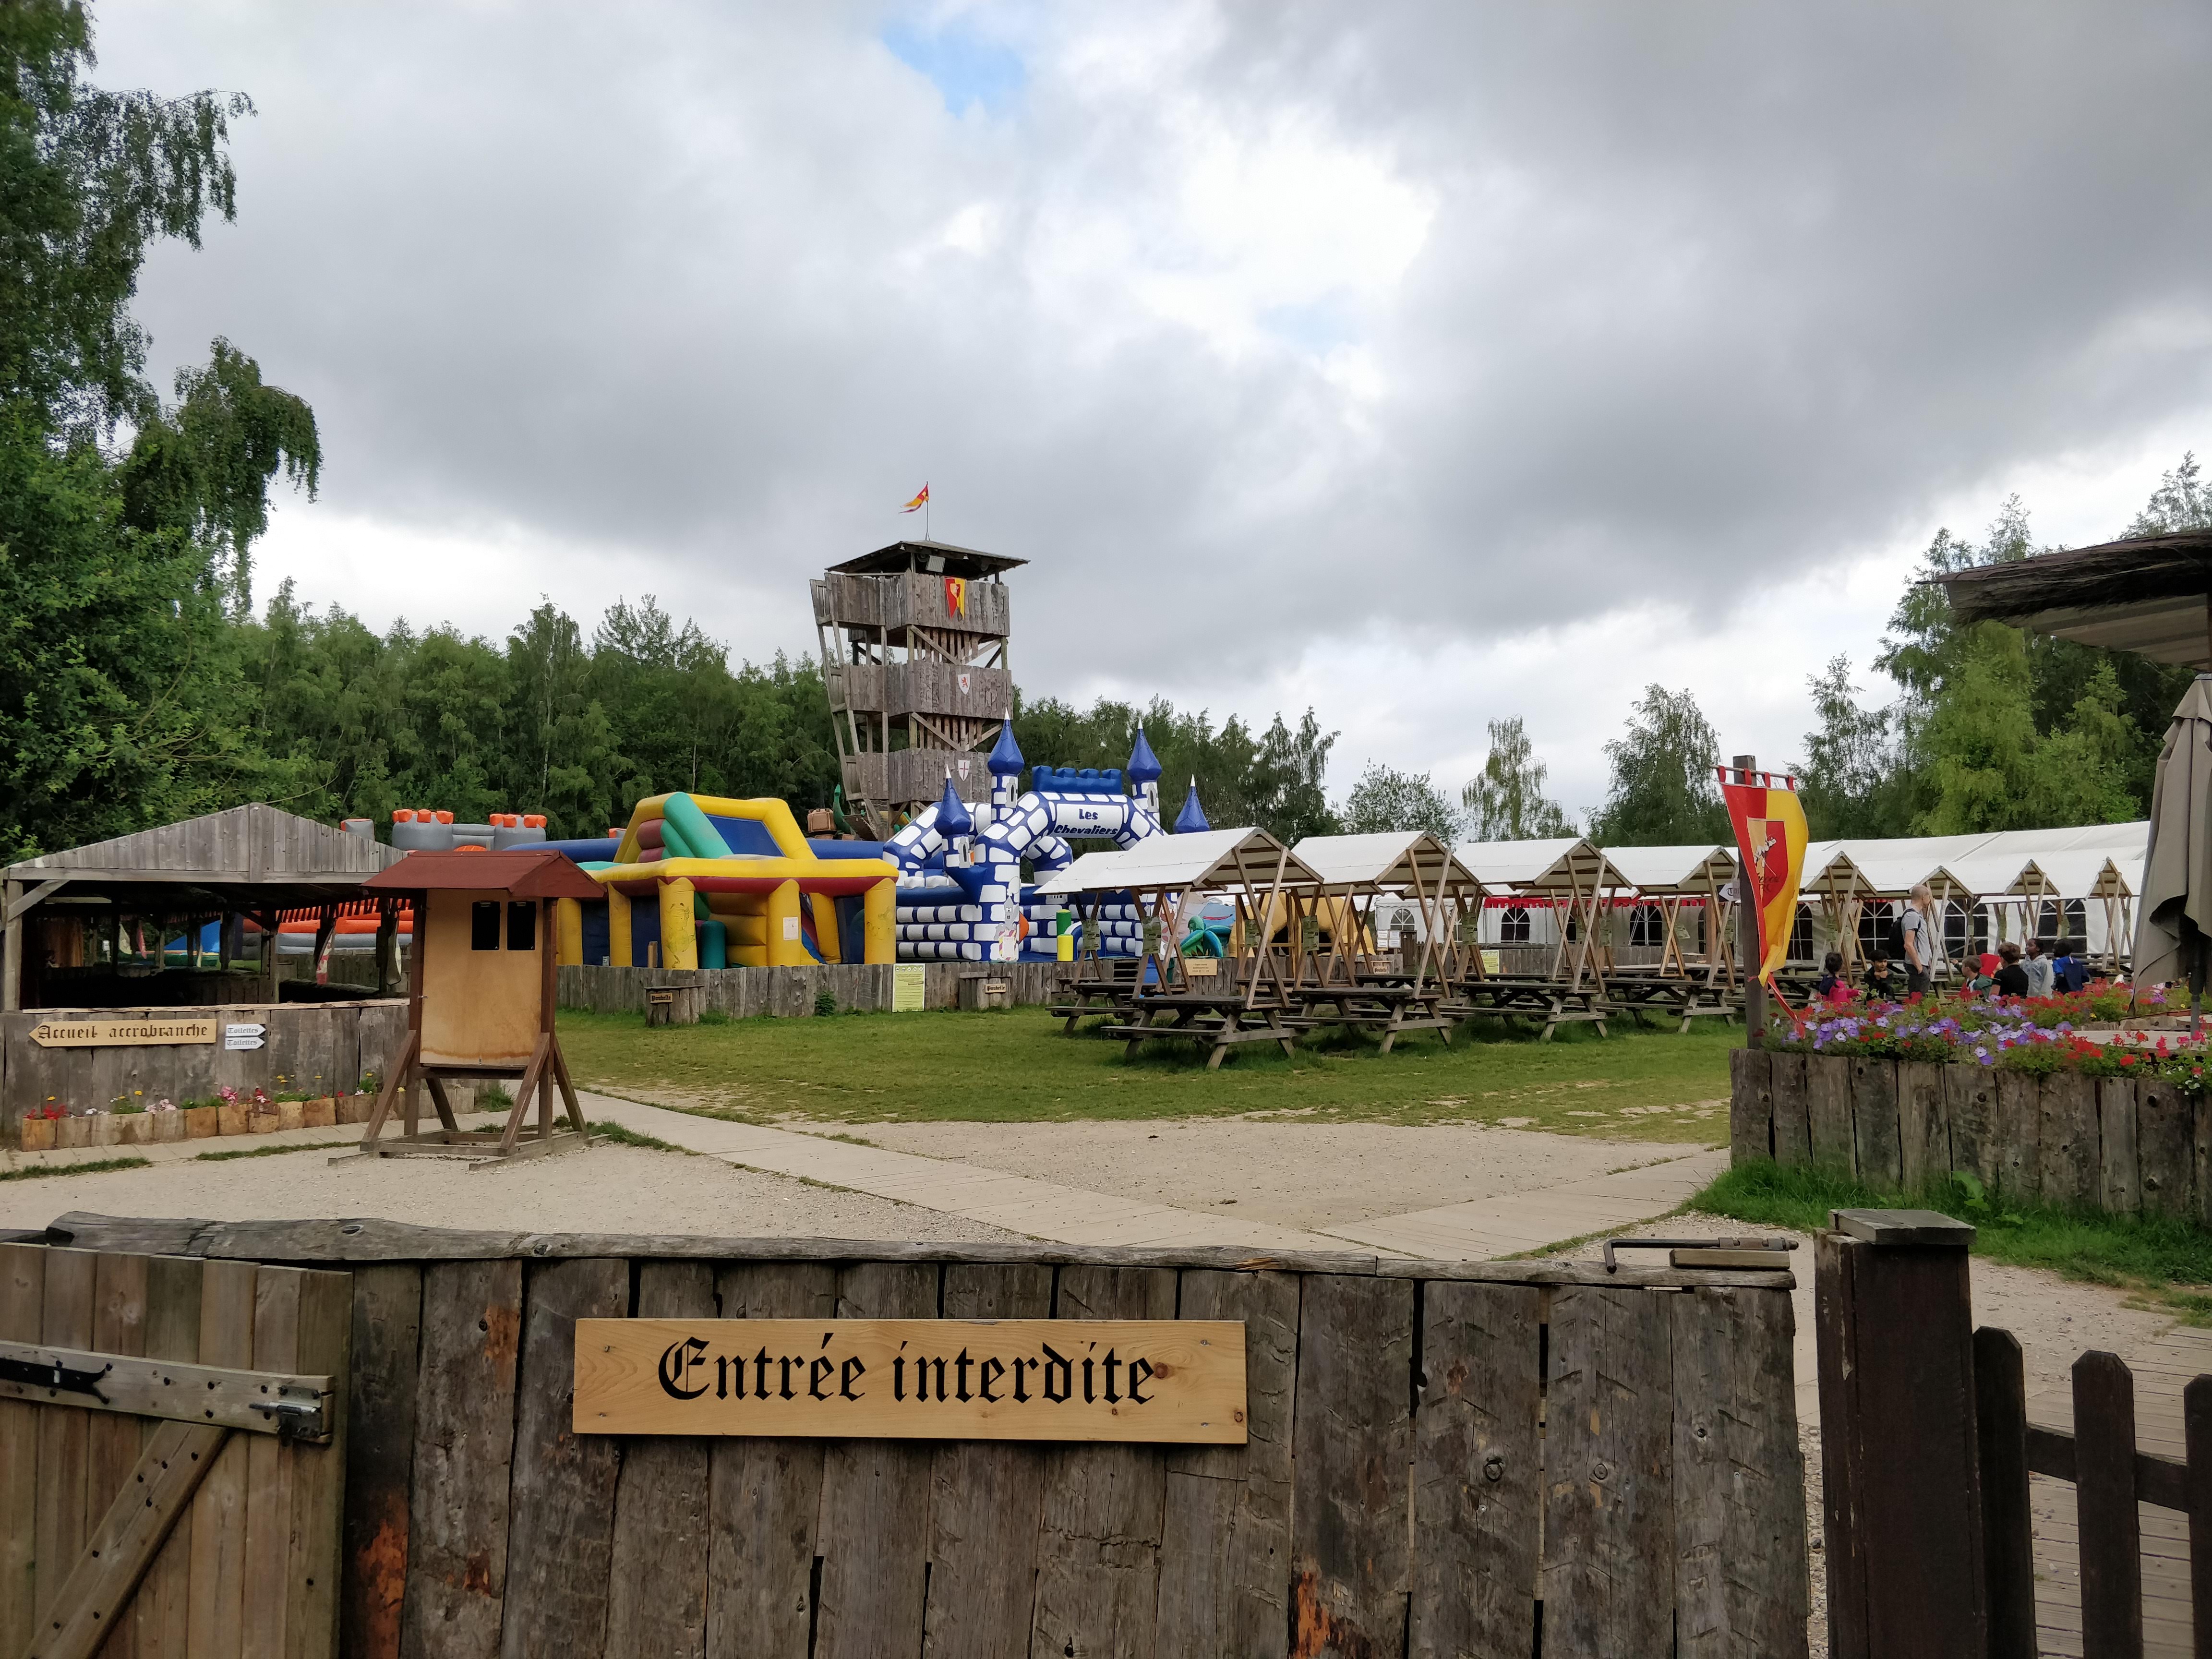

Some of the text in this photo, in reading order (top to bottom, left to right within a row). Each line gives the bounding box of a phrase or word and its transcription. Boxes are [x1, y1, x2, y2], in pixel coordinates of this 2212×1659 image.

[1079, 808, 1098, 820] Les
[1054, 824, 1118, 834] Chevaliers
[37, 1023, 208, 1039] Accueil accrobranche
[658, 1333, 1155, 1405] Entrée interdite
